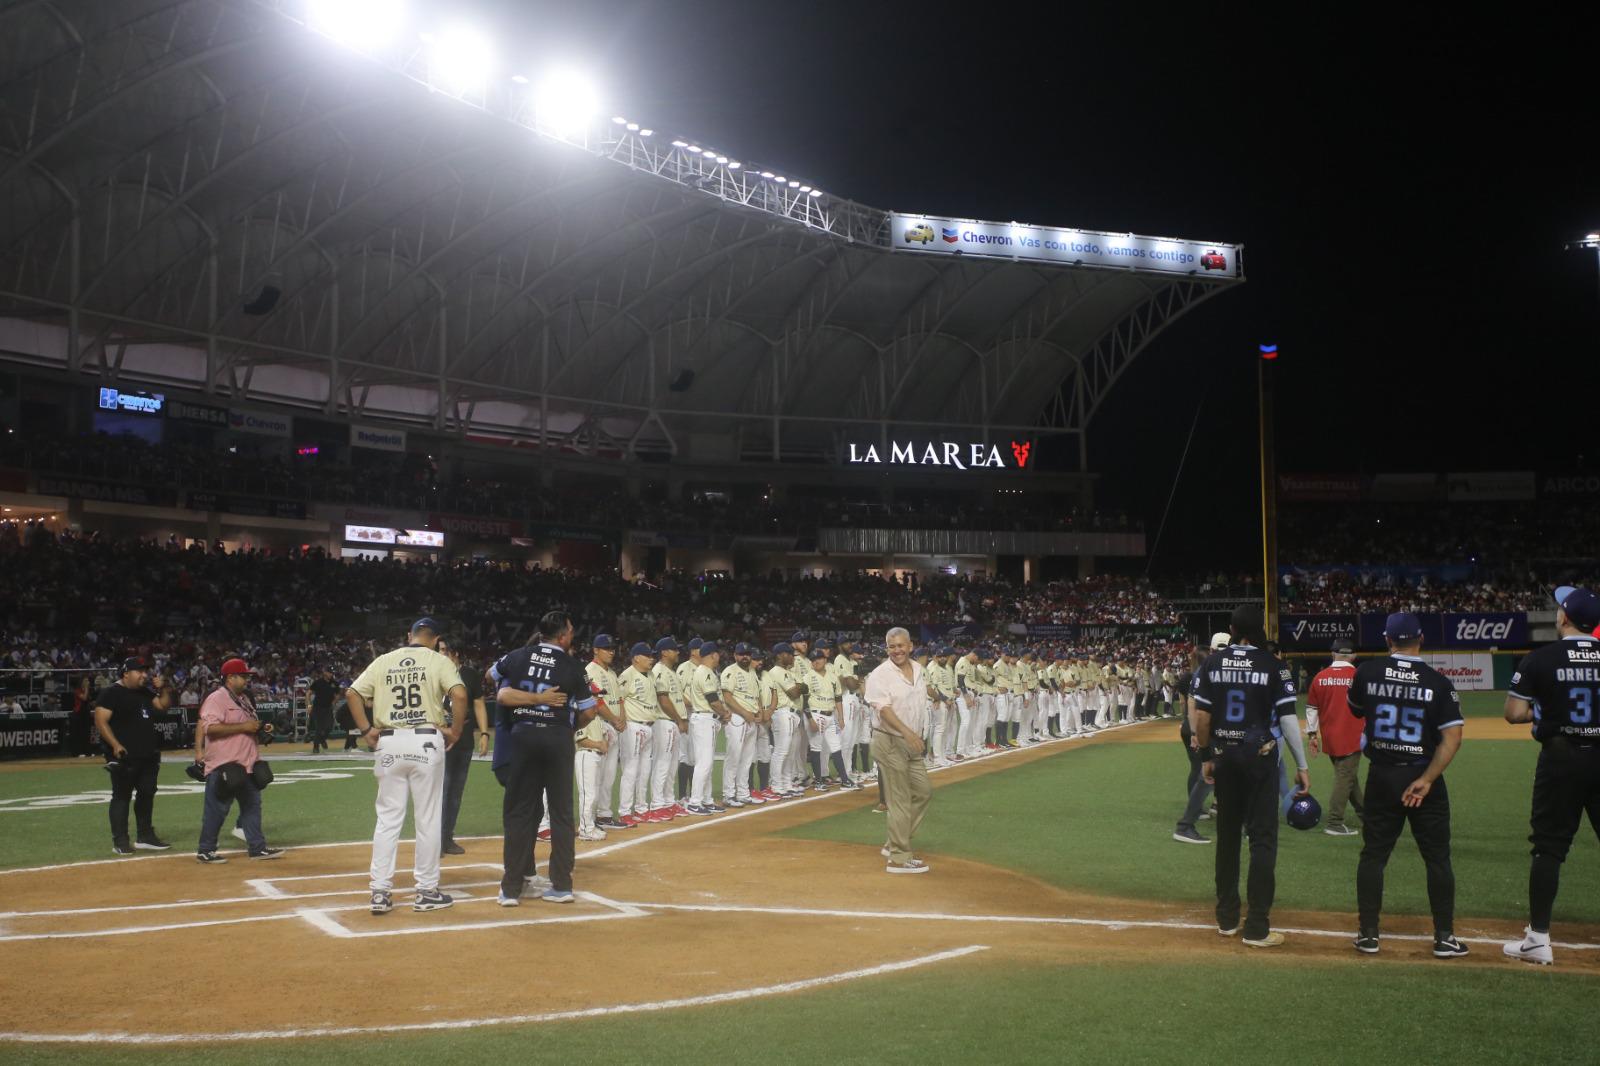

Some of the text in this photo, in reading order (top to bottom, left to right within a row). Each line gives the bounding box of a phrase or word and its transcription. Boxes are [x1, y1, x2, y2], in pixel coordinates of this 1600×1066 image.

[963, 231, 1195, 264] Chevron Vas con todo, vamos contigo
[246, 416, 287, 433] Chevron
[849, 440, 1006, 470] LA MAREA
[1308, 623, 1355, 633] VIZSLA
[1456, 618, 1514, 640] telcel
[530, 652, 557, 665] Brück
[1222, 656, 1254, 668] Brück
[407, 665, 427, 673] Azteca
[1385, 667, 1420, 681] Brück
[386, 672, 428, 686] RIVERA
[1209, 670, 1269, 686] HAMILTON
[391, 683, 422, 710] 36
[1367, 681, 1433, 702] MAYFIELD
[1225, 689, 1246, 723] 6
[390, 709, 427, 721] Kelder
[1374, 703, 1425, 743] 25
